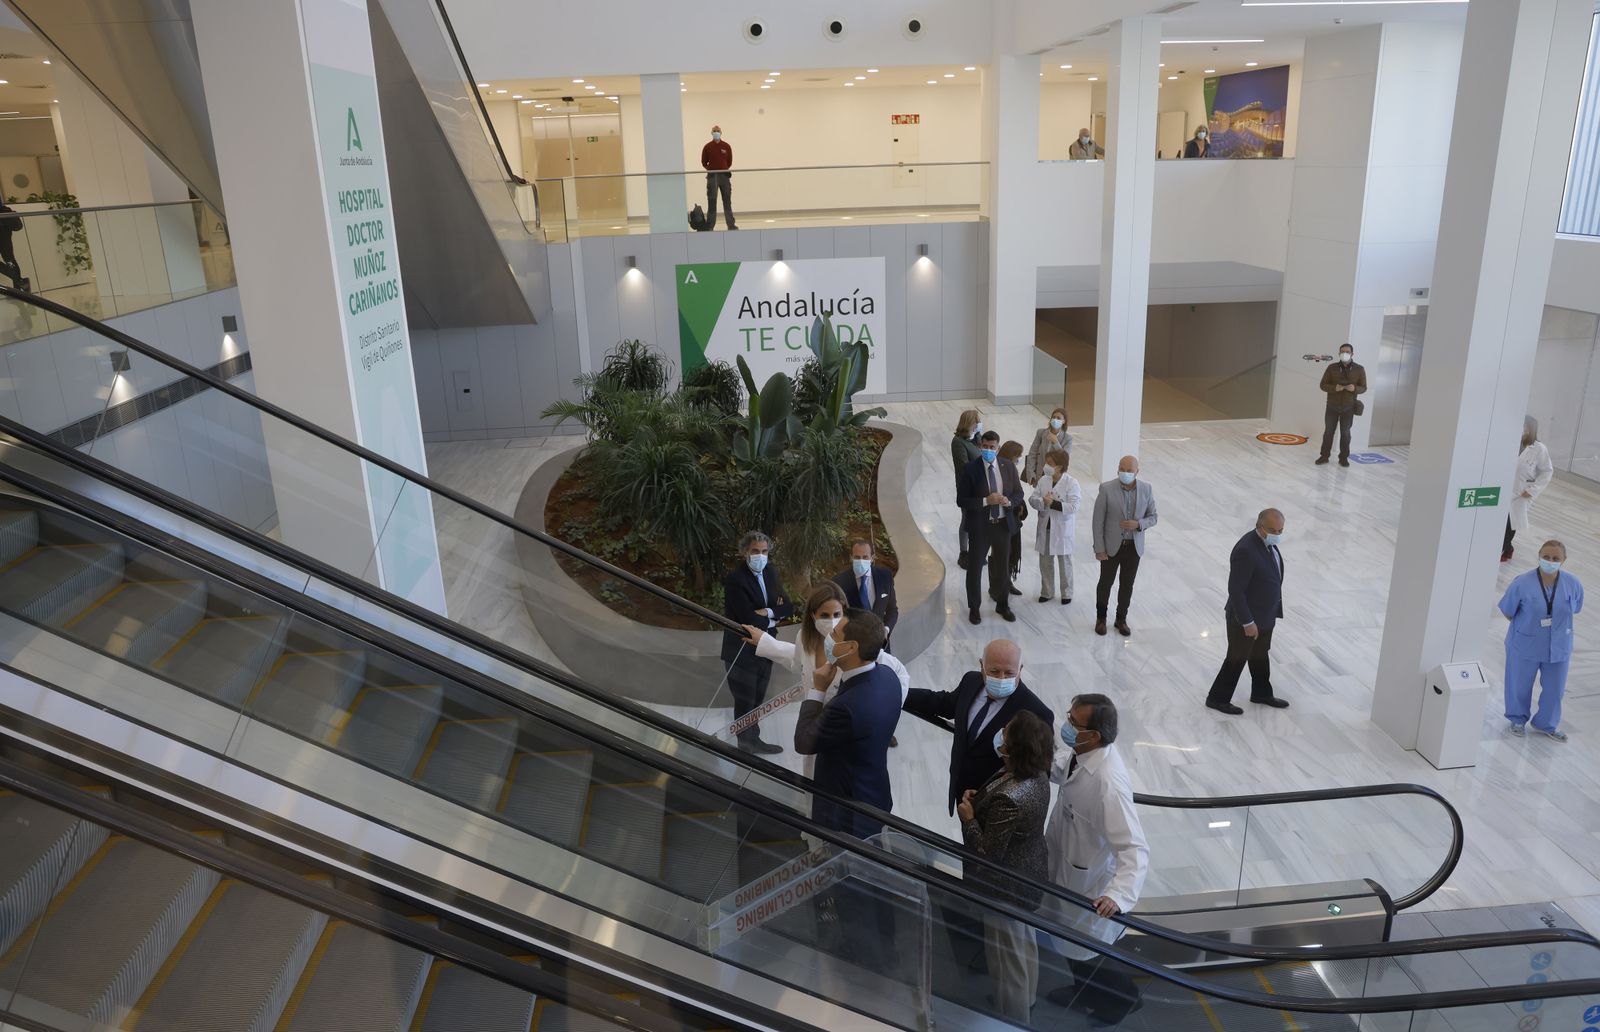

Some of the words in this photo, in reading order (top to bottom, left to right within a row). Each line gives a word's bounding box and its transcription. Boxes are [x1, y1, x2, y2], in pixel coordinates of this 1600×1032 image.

[338, 188, 384, 213] HOSPITAL
[346, 220, 384, 247] DOCTOR
[353, 248, 386, 280] MUÑOZ
[348, 279, 399, 316] CARIÑANOS
[738, 288, 875, 319] Andalucía
[359, 331, 377, 349] Distrito
[377, 320, 400, 340] Sanitario
[739, 327, 775, 352] TE
[774, 695, 787, 707] NO
[730, 706, 772, 735] CLIMBING
[792, 856, 809, 874] NO
[735, 867, 790, 908] CLIMBING
[795, 878, 813, 898] NO
[736, 889, 793, 931] CLIMBING
